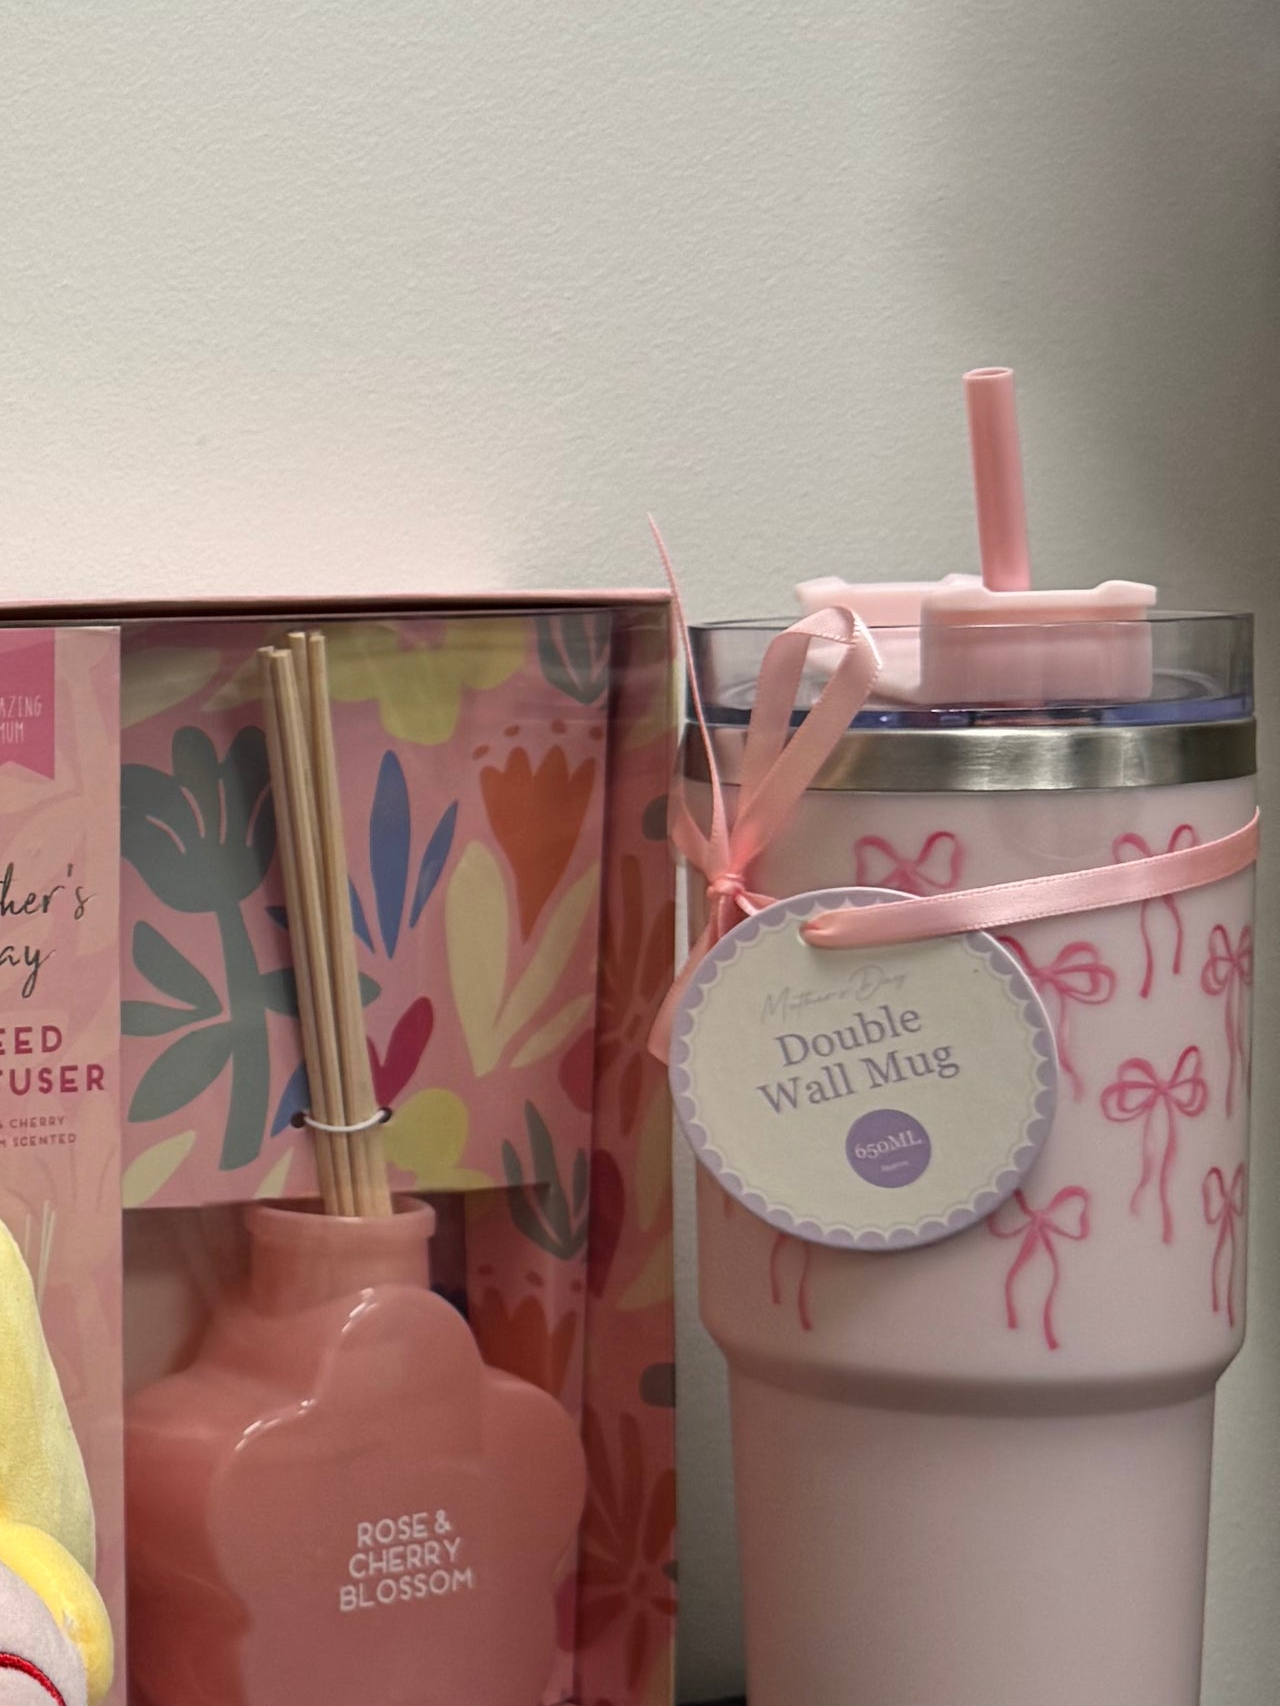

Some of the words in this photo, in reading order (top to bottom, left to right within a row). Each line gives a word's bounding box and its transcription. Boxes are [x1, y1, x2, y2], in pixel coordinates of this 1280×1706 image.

[774, 1004, 922, 1068] Double
[757, 1062, 856, 1115] Wall
[864, 1041, 961, 1090] Mug
[9, 1116, 65, 1129] CHERRY
[13, 1133, 77, 1147] SCENTED
[855, 1130, 922, 1159] 650ML
[357, 1512, 428, 1549] ROSE
[434, 1509, 452, 1534] &
[348, 1537, 464, 1580] CHERRY
[340, 1567, 473, 1612] BLOSSOM
